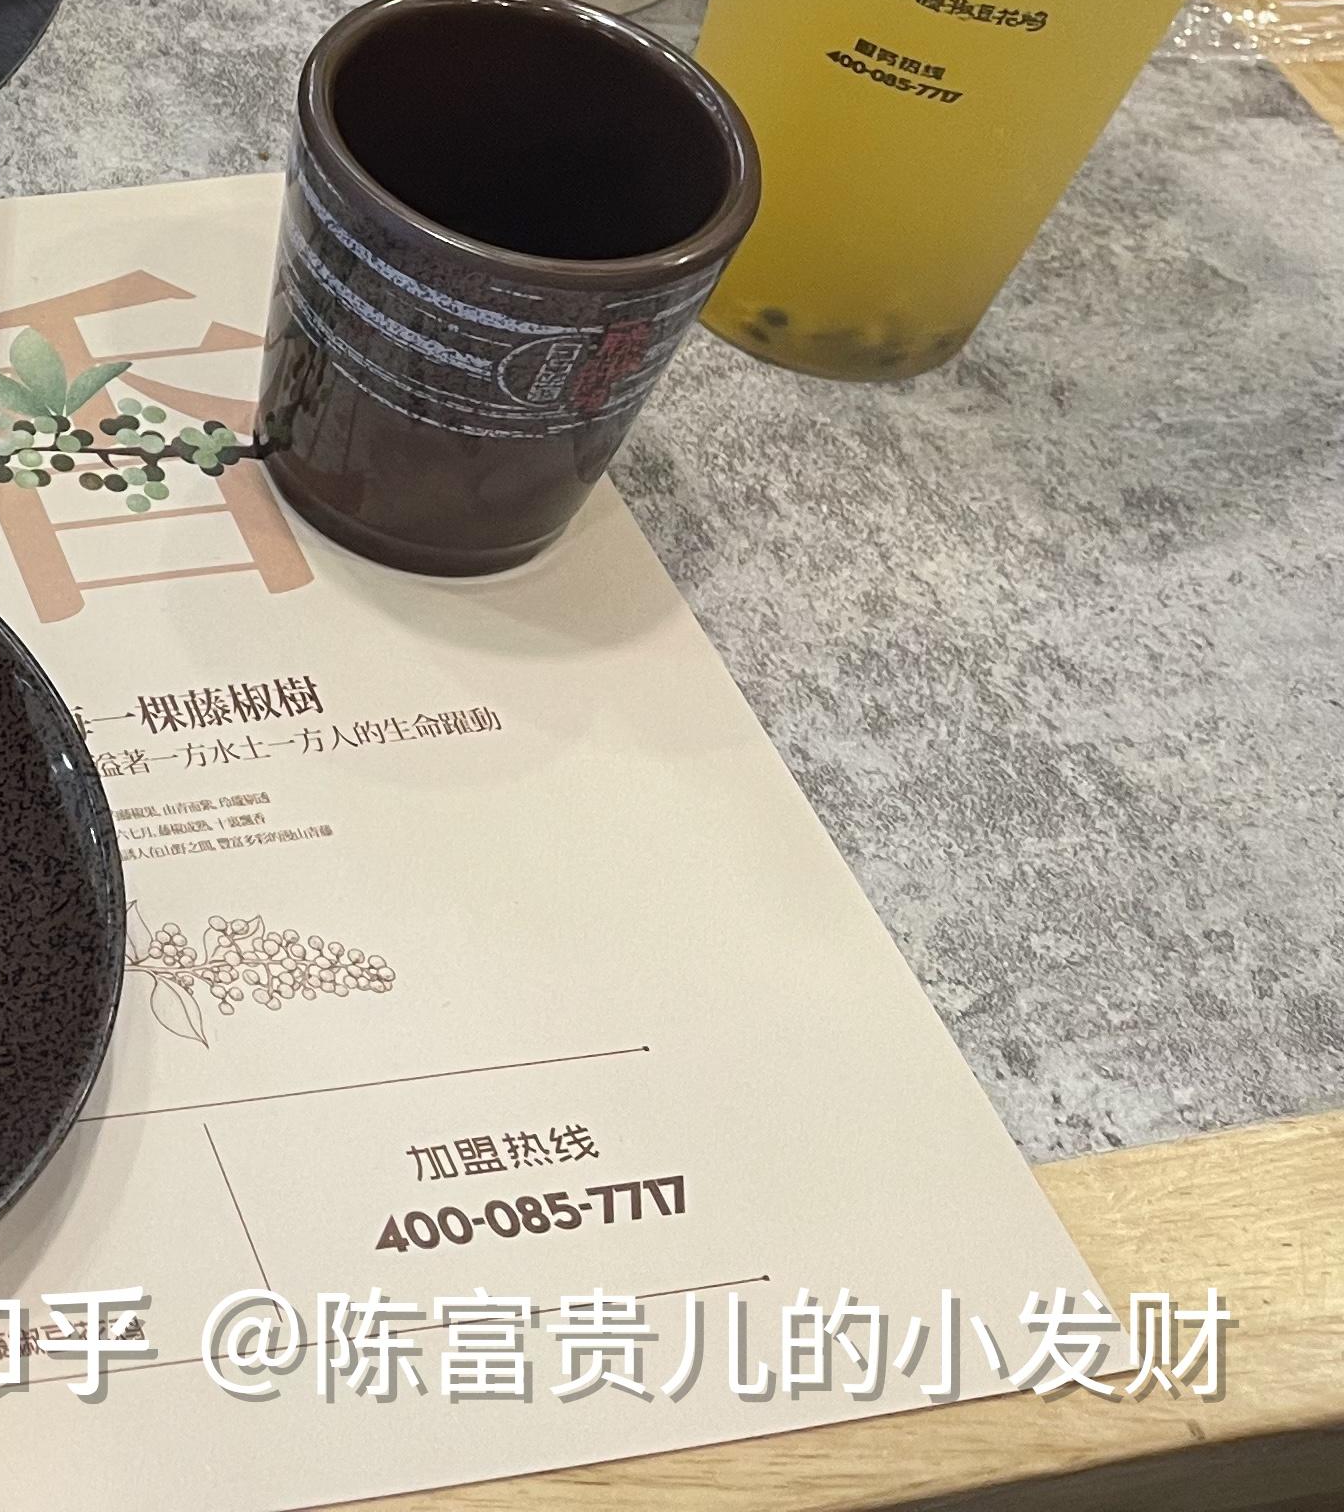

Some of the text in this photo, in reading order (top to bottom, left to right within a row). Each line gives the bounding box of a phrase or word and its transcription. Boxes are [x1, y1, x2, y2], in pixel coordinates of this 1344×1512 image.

[406, 1124, 600, 1182] 加盟热线
[374, 1175, 686, 1253] 400-085-7717
